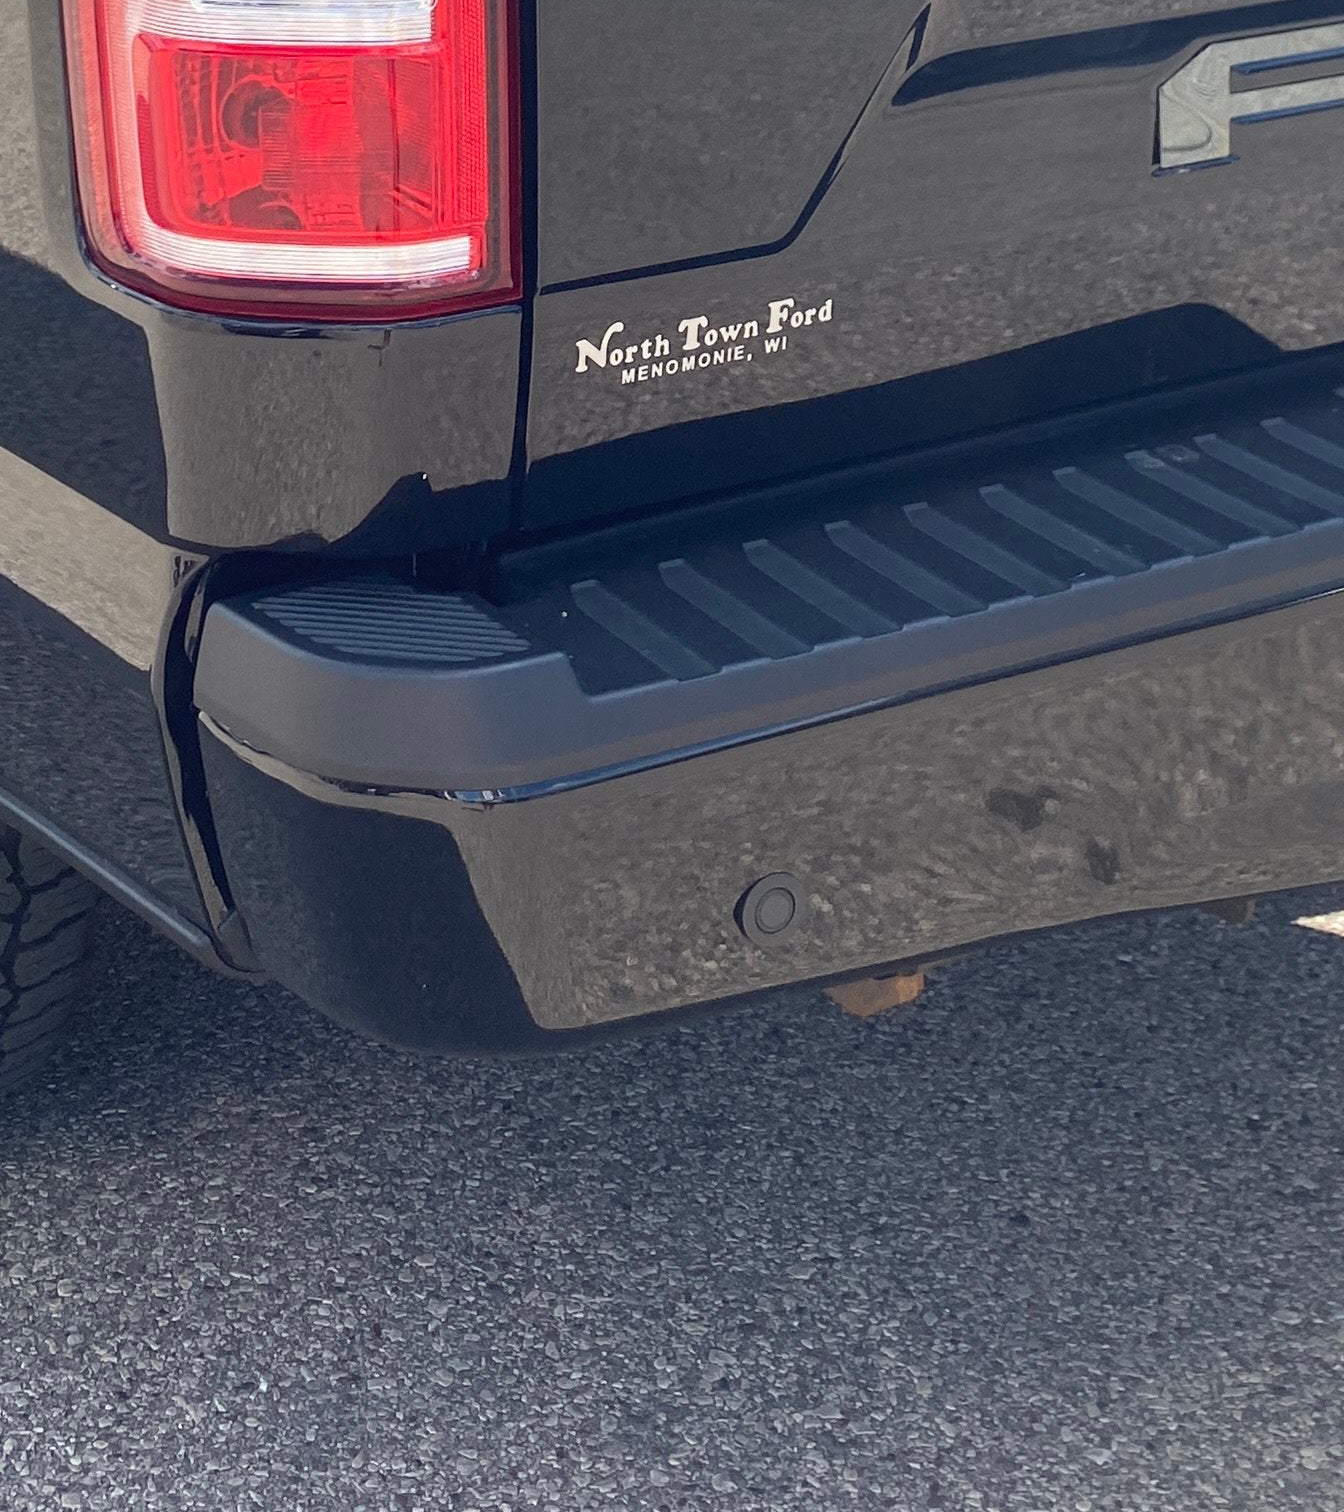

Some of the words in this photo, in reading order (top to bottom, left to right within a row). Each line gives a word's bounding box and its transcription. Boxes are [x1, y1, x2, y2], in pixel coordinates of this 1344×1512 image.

[574, 321, 670, 373] North
[677, 315, 759, 351] Town
[765, 297, 833, 334] Ford
[620, 344, 754, 385] MENOMONIE,
[763, 335, 788, 354] WI
